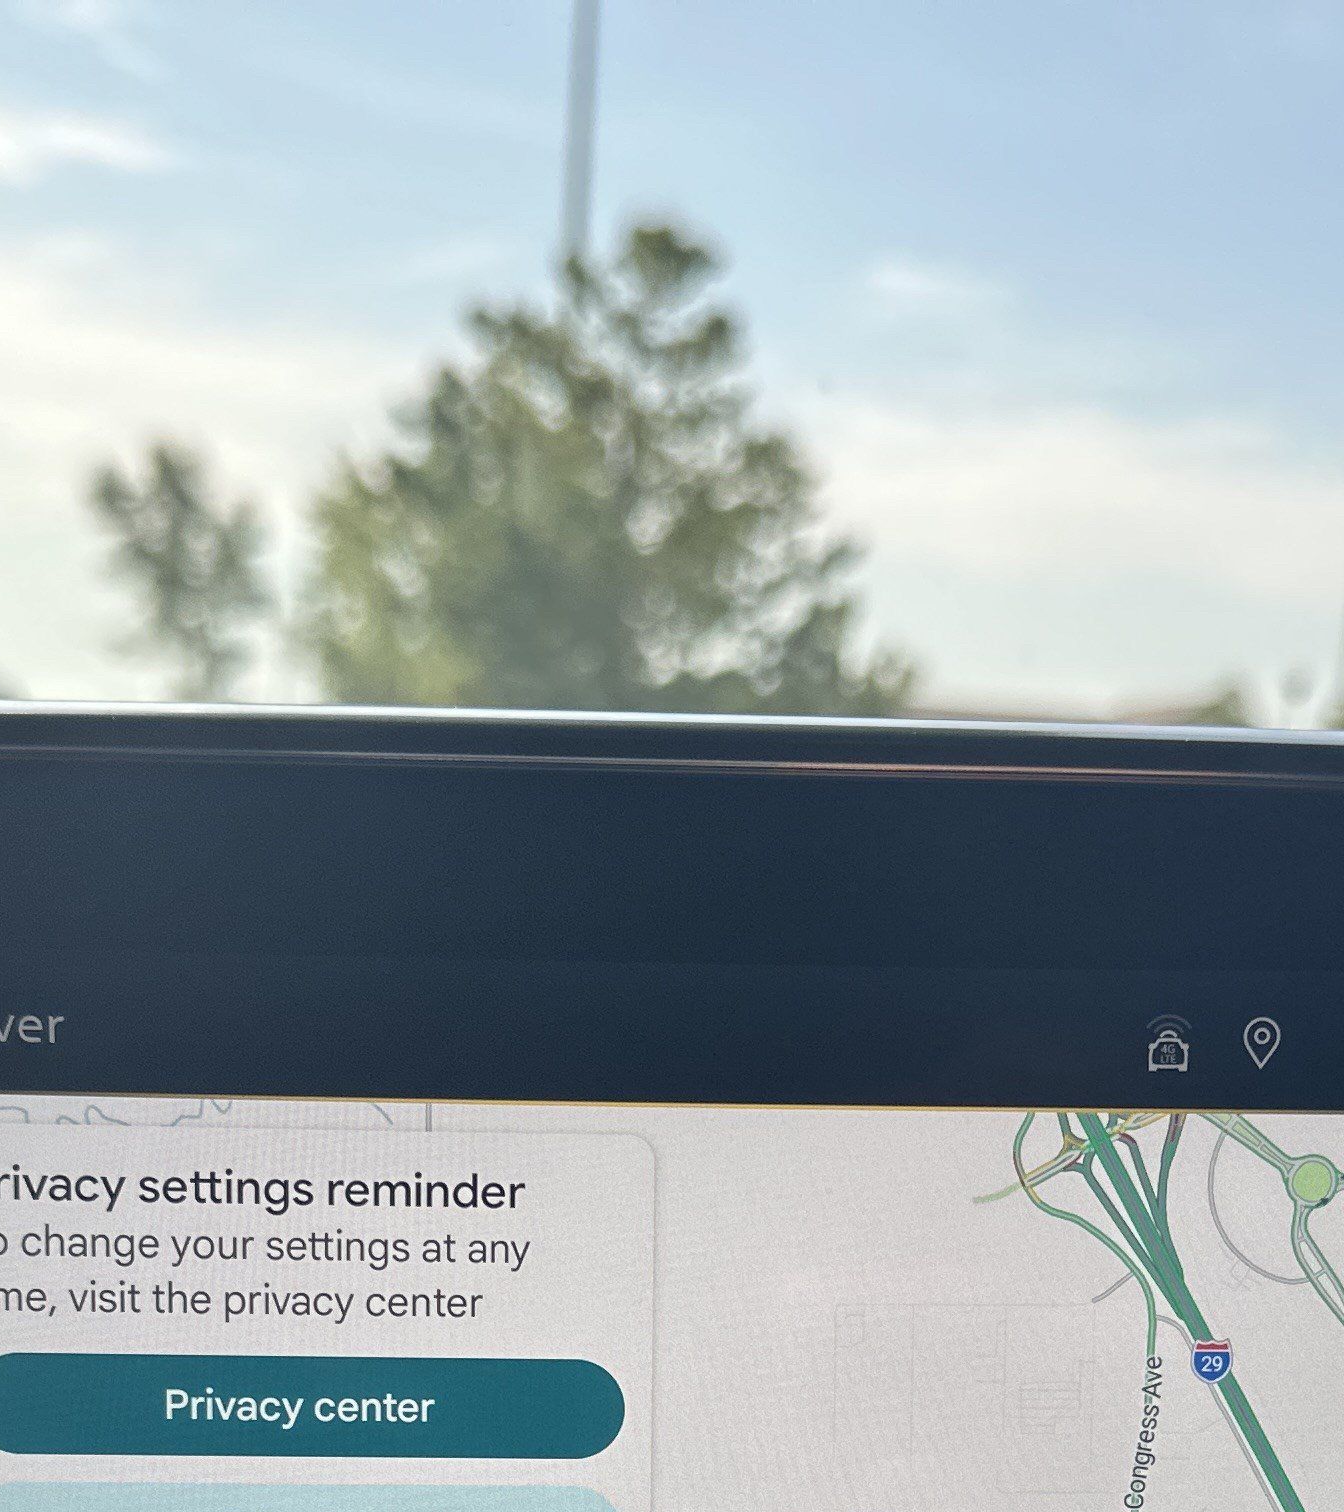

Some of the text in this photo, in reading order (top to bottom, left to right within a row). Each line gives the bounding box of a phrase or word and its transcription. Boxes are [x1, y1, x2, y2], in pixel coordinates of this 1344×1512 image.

[1160, 1044, 1176, 1054] 4G
[1160, 1054, 1177, 1064] LTE
[138, 1168, 314, 1216] settings
[328, 1171, 526, 1209] reminder
[21, 1223, 160, 1267] change
[171, 1231, 254, 1268] your
[266, 1228, 411, 1271] settings
[422, 1231, 456, 1264] at
[468, 1236, 531, 1273] any
[68, 1280, 141, 1315] visit
[152, 1281, 211, 1315] the
[224, 1284, 355, 1325] privacy
[365, 1287, 484, 1318] center
[1141, 1355, 1163, 1399] Ave
[1201, 1355, 1223, 1373] 29
[165, 1386, 436, 1430] Privacy center
[1123, 1403, 1160, 1510] Congress
